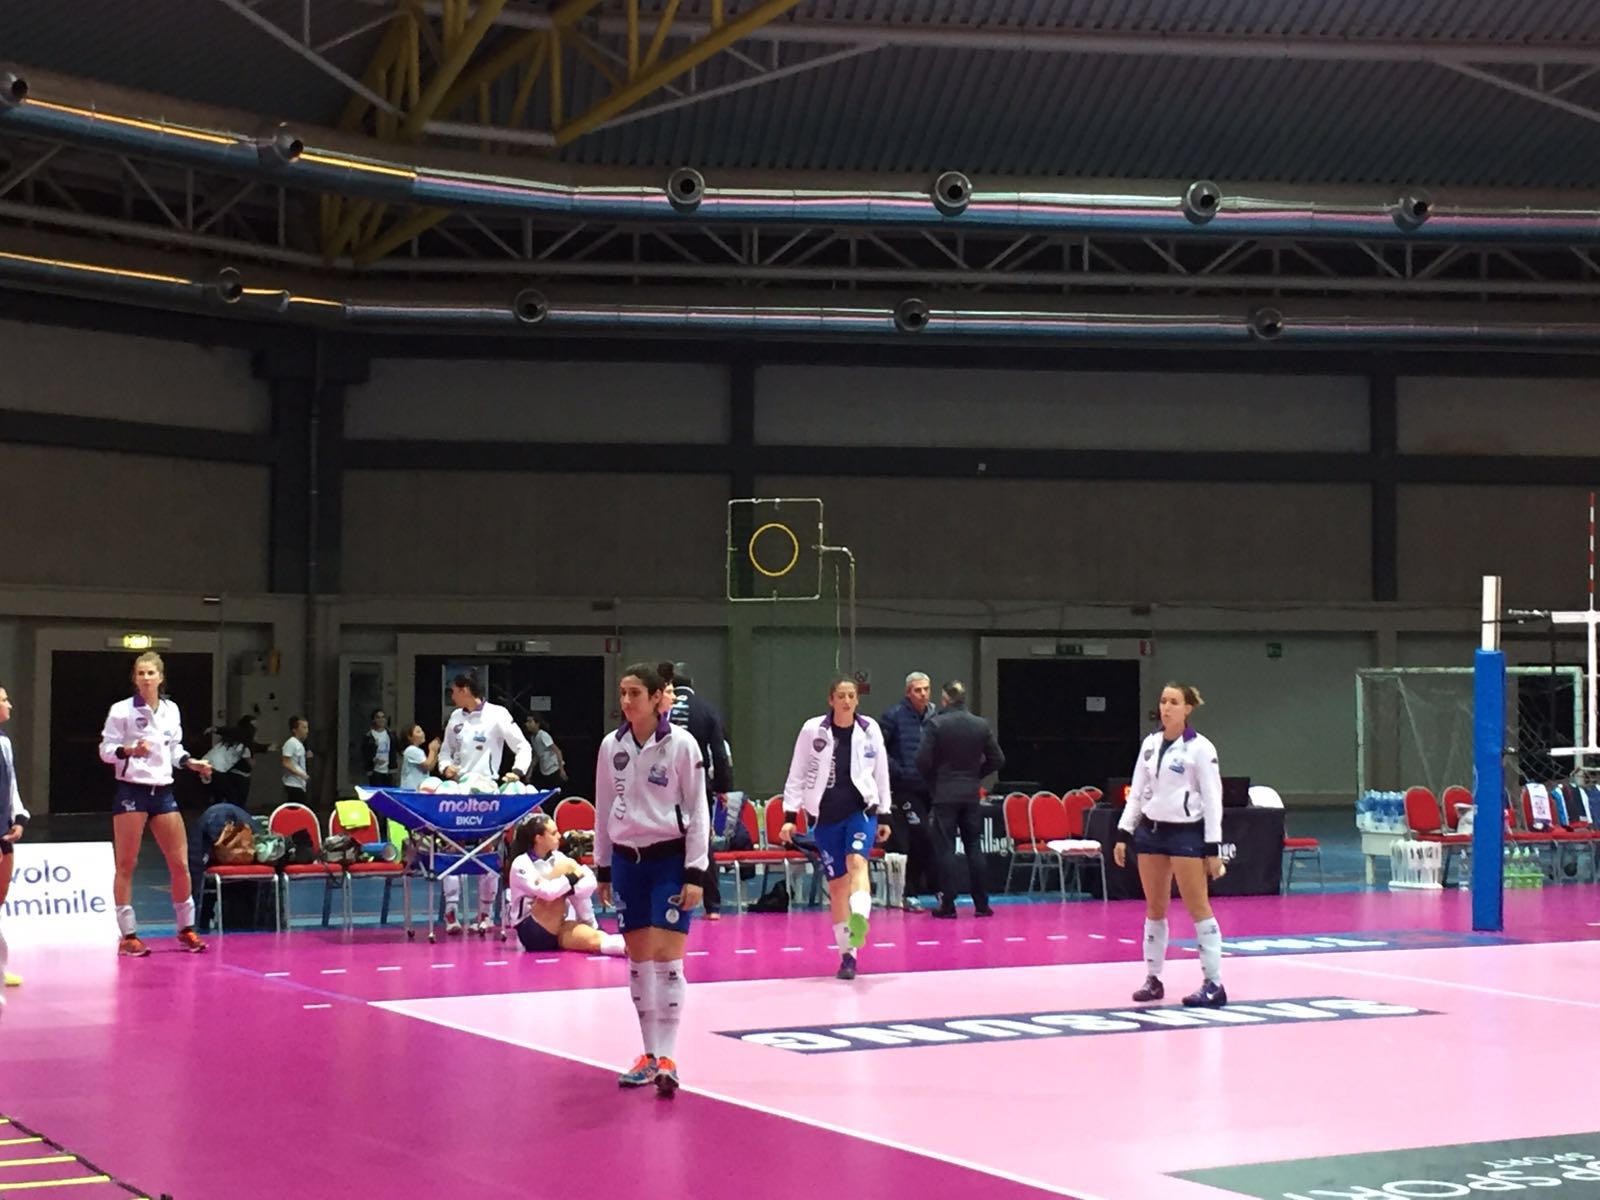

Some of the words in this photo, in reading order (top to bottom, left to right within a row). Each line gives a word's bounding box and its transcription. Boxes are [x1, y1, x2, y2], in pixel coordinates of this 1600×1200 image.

[438, 798, 500, 812] molten
[455, 815, 483, 825] BKCV
[4, 889, 106, 917] minile
[740, 999, 1420, 1050] SAMSUNG
